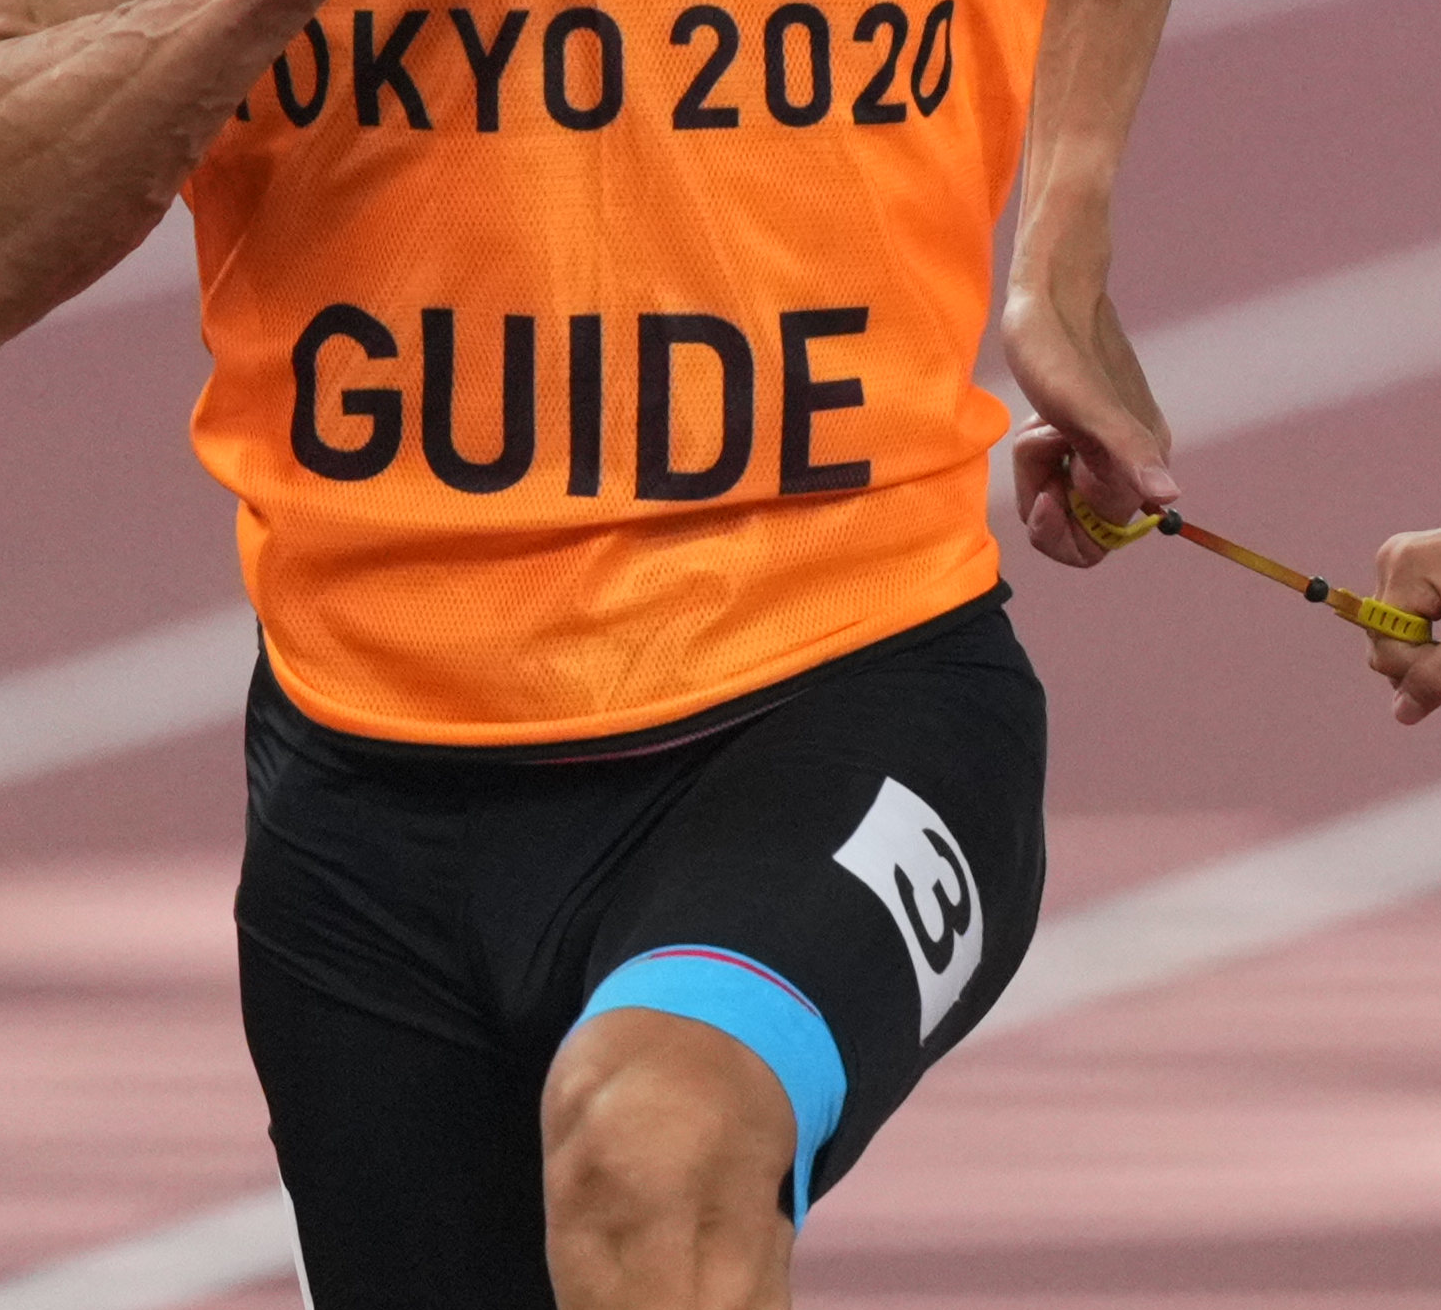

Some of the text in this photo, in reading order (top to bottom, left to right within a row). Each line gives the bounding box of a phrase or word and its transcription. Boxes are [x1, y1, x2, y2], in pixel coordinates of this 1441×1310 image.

[235, 0, 955, 132] OKYO 2020
[290, 303, 873, 502] GUIDE
[894, 827, 973, 976] 3
